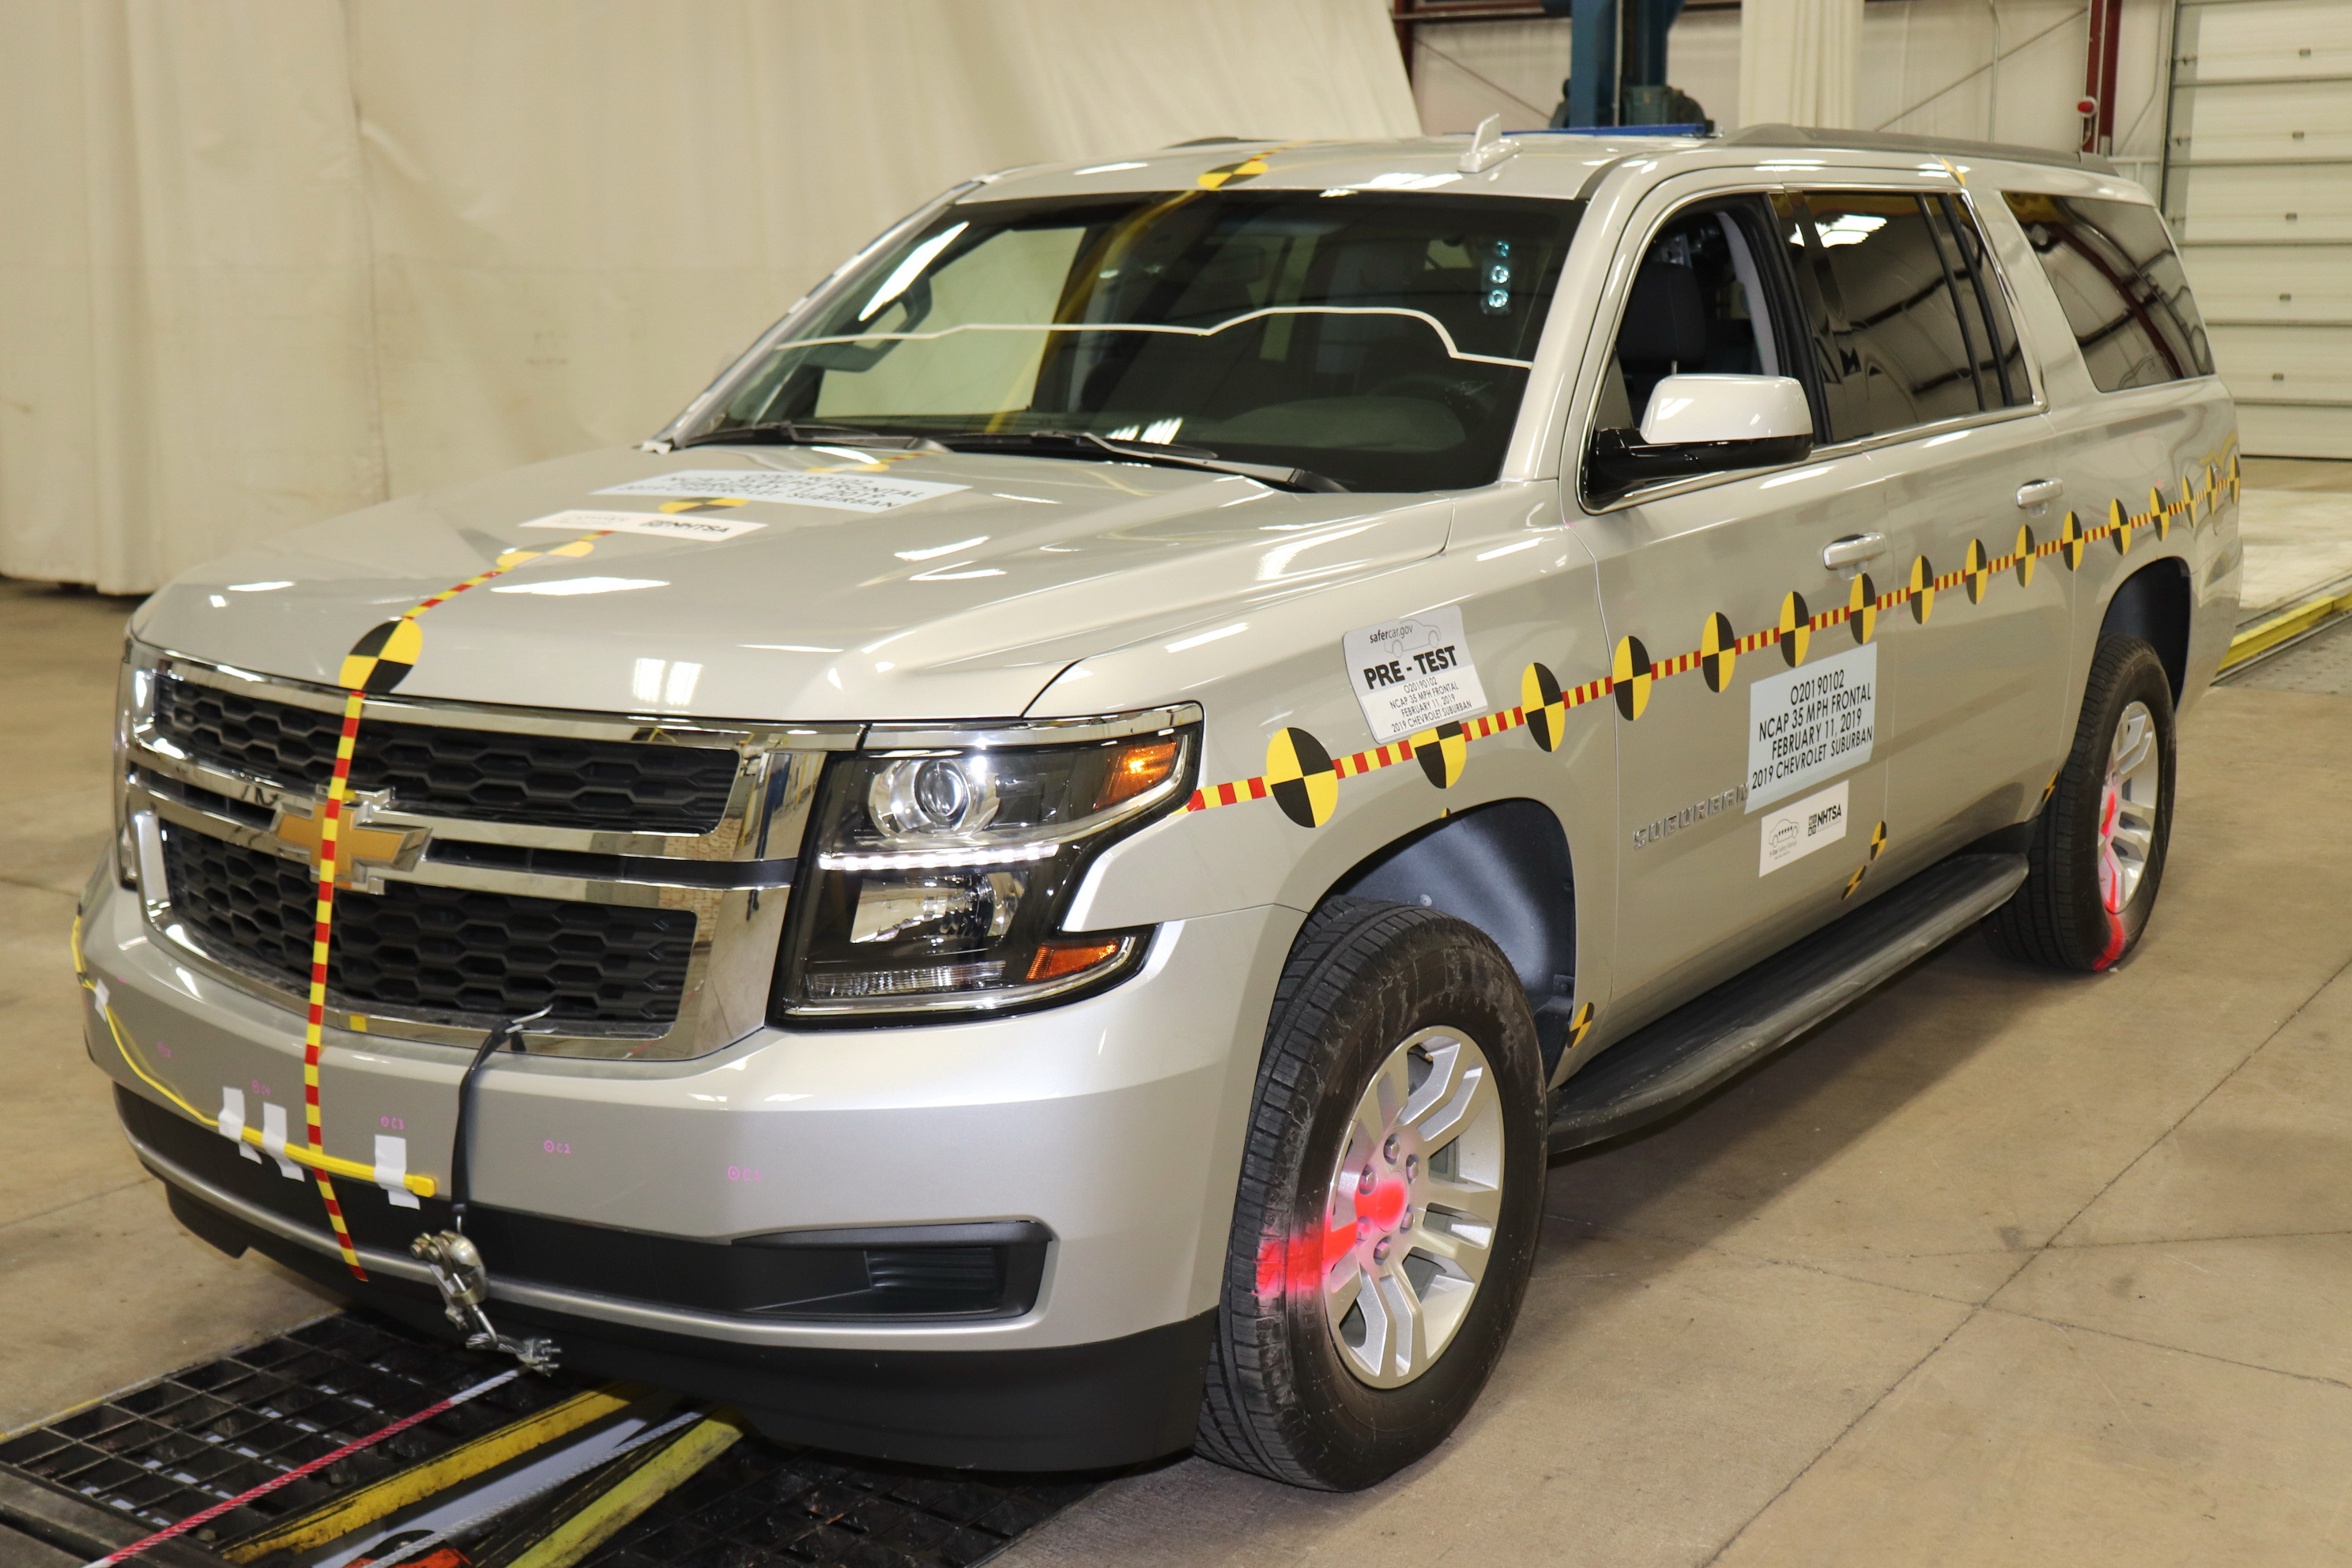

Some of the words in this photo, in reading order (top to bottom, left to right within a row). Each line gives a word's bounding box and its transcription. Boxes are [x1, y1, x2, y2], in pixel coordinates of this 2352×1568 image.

[1370, 624, 1413, 644] safercar.gov
[1363, 660, 1405, 690] PRE
[1413, 645, 1458, 675] TEST
[1389, 695, 1408, 710] NCAP
[1409, 694, 1418, 703] 35
[1418, 691, 1432, 702] MPH
[1432, 681, 1459, 698] FRONTAL
[1401, 699, 1431, 718] FEBRUARY
[1442, 694, 1456, 707] 2019
[1759, 714, 1789, 742] NCAP
[1792, 707, 1804, 728] 35
[1806, 698, 1828, 723] MPH
[1831, 682, 1871, 715] FRONTAL
[1391, 721, 1407, 733] 2019
[1408, 710, 1443, 729] CHEVROLET
[1443, 700, 1472, 717] SUBURBAN
[1772, 722, 1822, 760] FEBRUARY
[1841, 708, 1862, 733] 2019
[1751, 764, 1774, 790] 2019
[1776, 743, 1827, 779] CHEVROLET
[1830, 726, 1873, 758] SUBURBAN
[1633, 782, 1748, 850] SUBURBAN
[1817, 803, 1842, 827] NHTSA
[742, 1167, 764, 1181] C1
